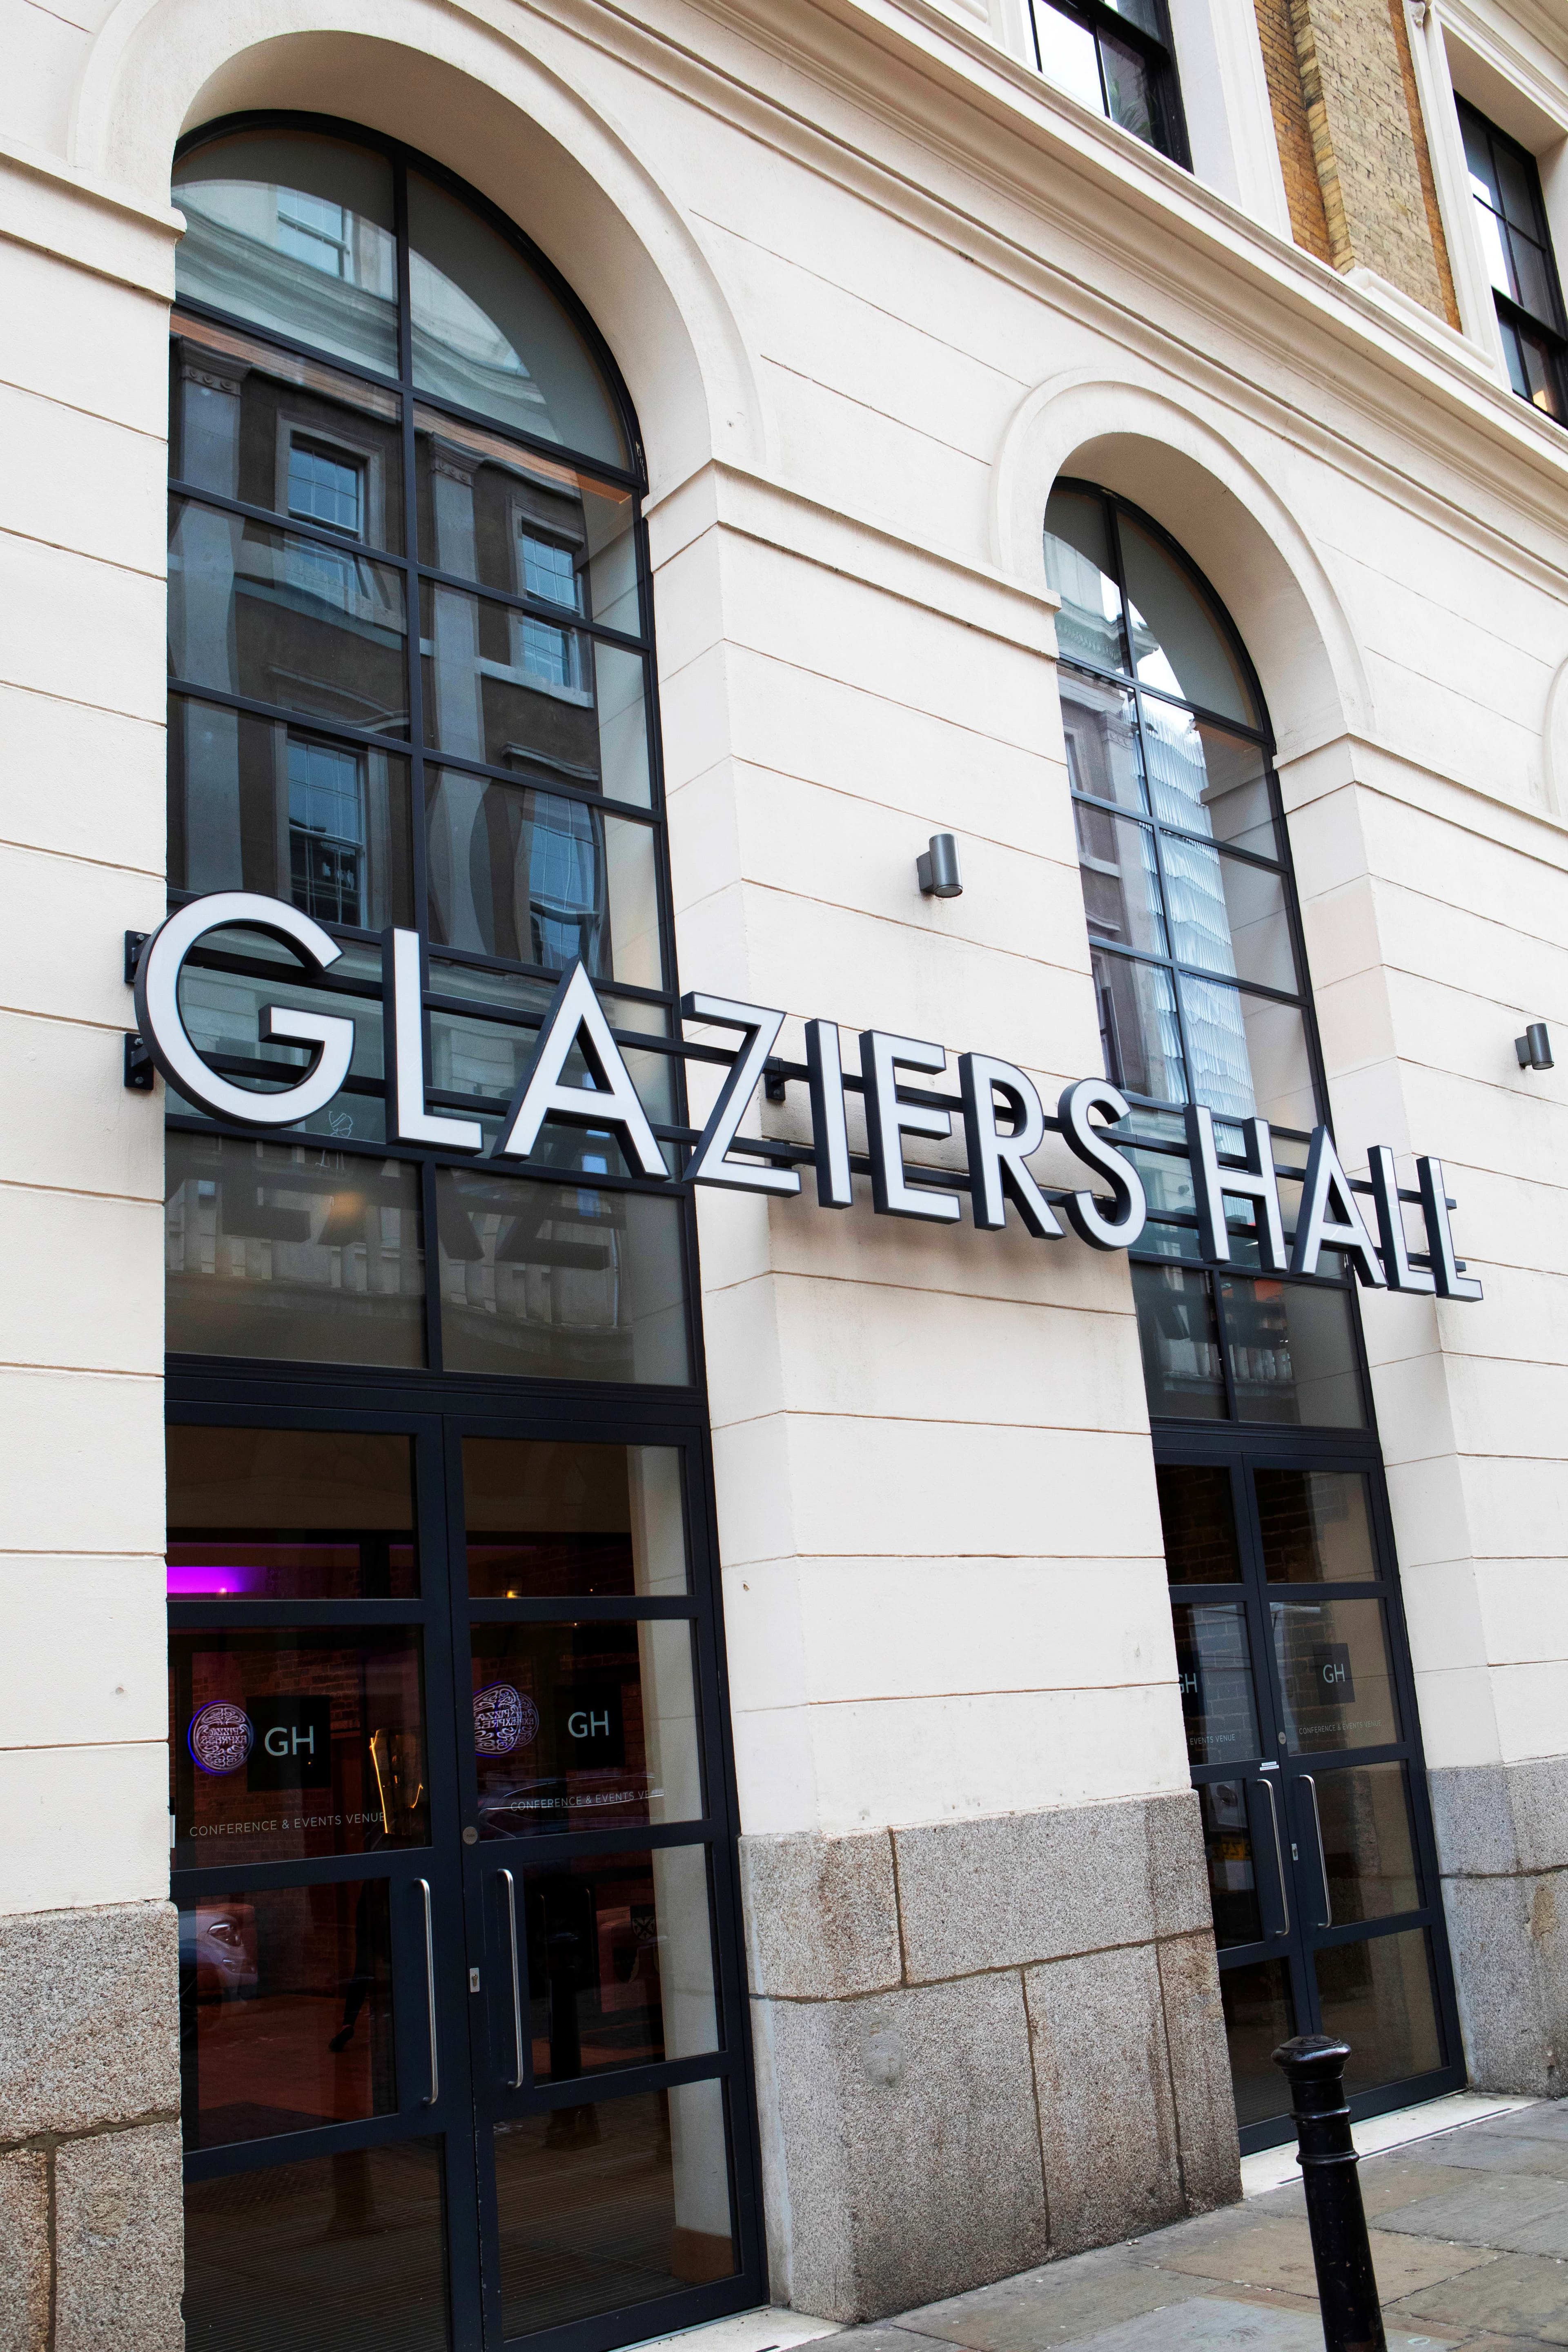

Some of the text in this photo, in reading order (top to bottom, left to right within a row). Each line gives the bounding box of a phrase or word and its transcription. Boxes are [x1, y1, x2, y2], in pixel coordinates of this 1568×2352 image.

[135, 891, 1483, 1303] GLAZIERS HALL
[1323, 1664, 1345, 1683] GH
[568, 1711, 609, 1738] GH
[1299, 1724, 1335, 1735] CONFERENCE
[1343, 1722, 1363, 1730] EVENTS
[1364, 1719, 1382, 1728] VENUE
[265, 1726, 314, 1756] GH
[1190, 1734, 1236, 1745] EVENTS VENUE
[510, 1797, 582, 1811] CONFERENCE
[586, 1795, 592, 1804] &
[596, 1791, 634, 1804] EVENTS
[190, 1812, 385, 1837] CONFERENCE & EVENTS VENUE
